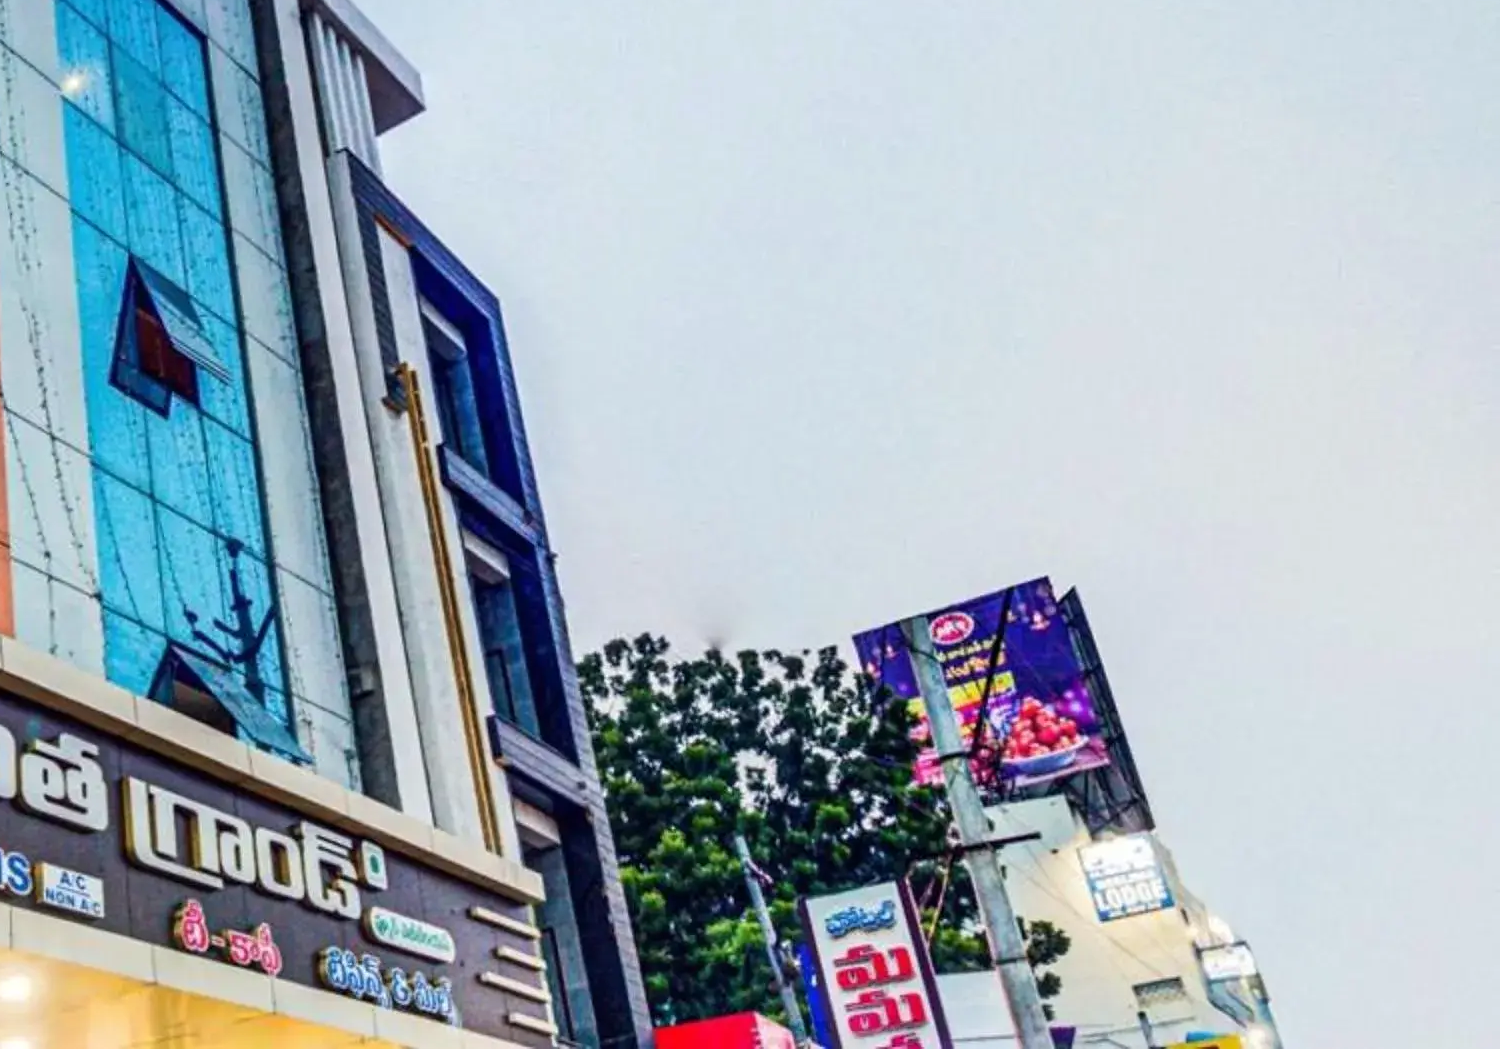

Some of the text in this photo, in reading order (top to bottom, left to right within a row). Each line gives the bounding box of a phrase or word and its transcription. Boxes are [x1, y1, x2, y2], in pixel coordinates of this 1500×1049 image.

[124, 775, 362, 920] గ్రాండ్
[45, 887, 76, 908] NON
[1093, 878, 1168, 910] LODGE
